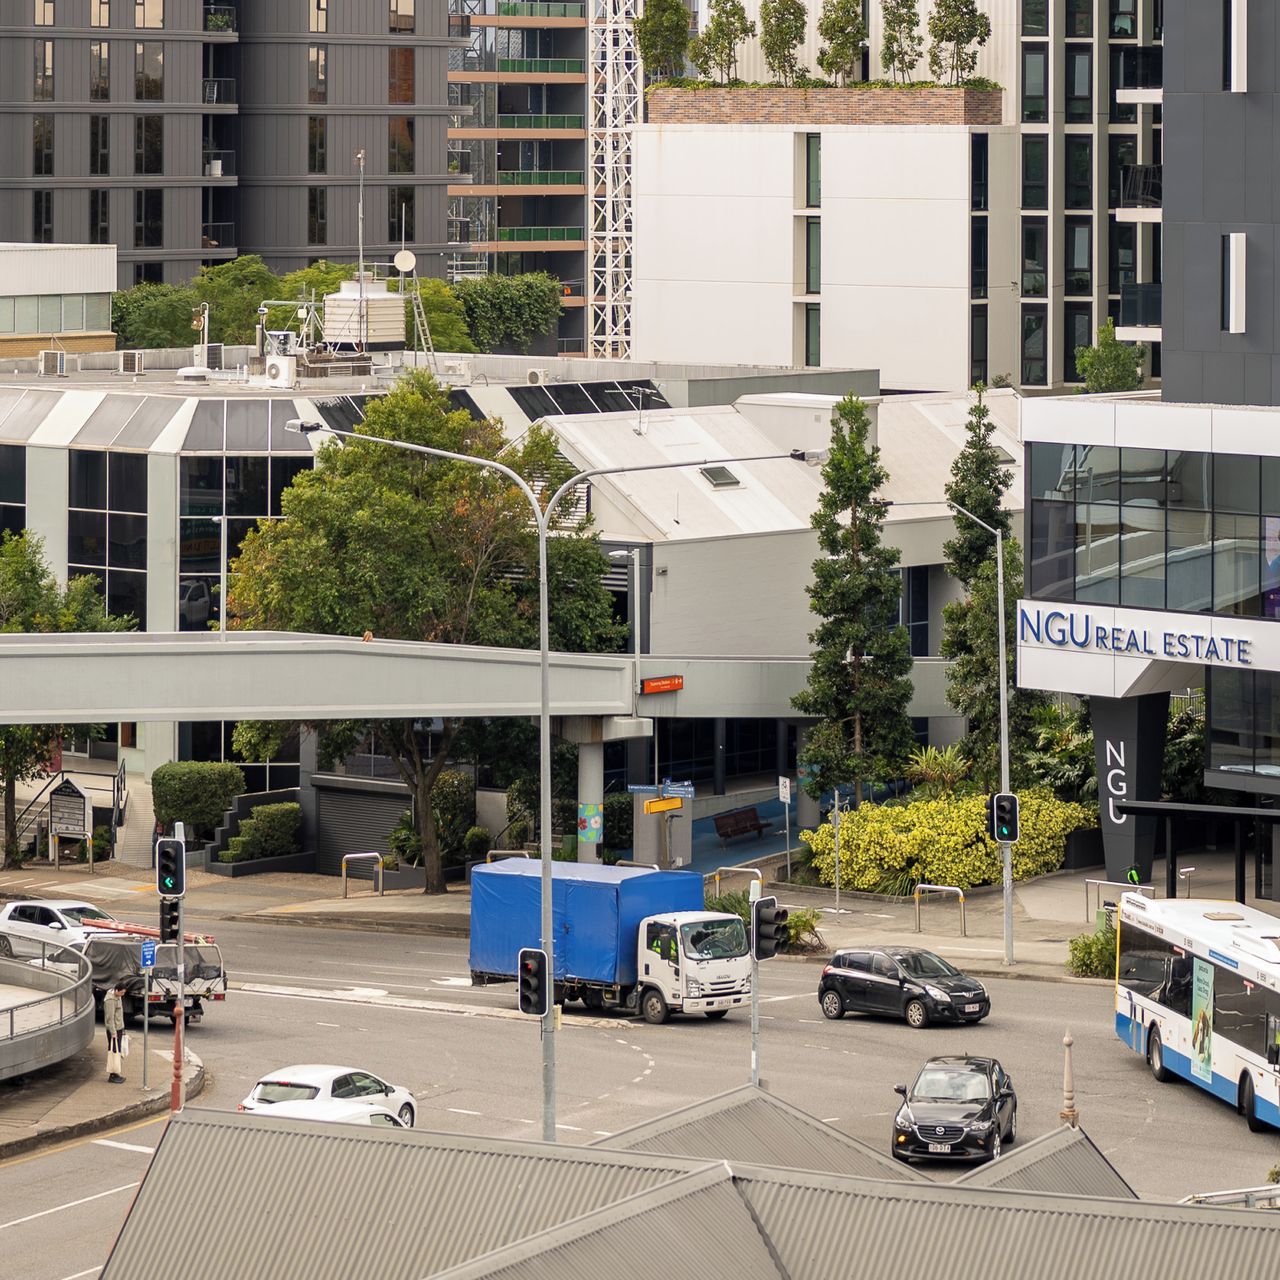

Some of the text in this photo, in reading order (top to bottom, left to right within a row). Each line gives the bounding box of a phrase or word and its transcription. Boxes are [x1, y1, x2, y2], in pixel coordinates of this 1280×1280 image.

[1020, 608, 1253, 664] NGU REAL ESTATE
[1106, 739, 1127, 824] NGU
